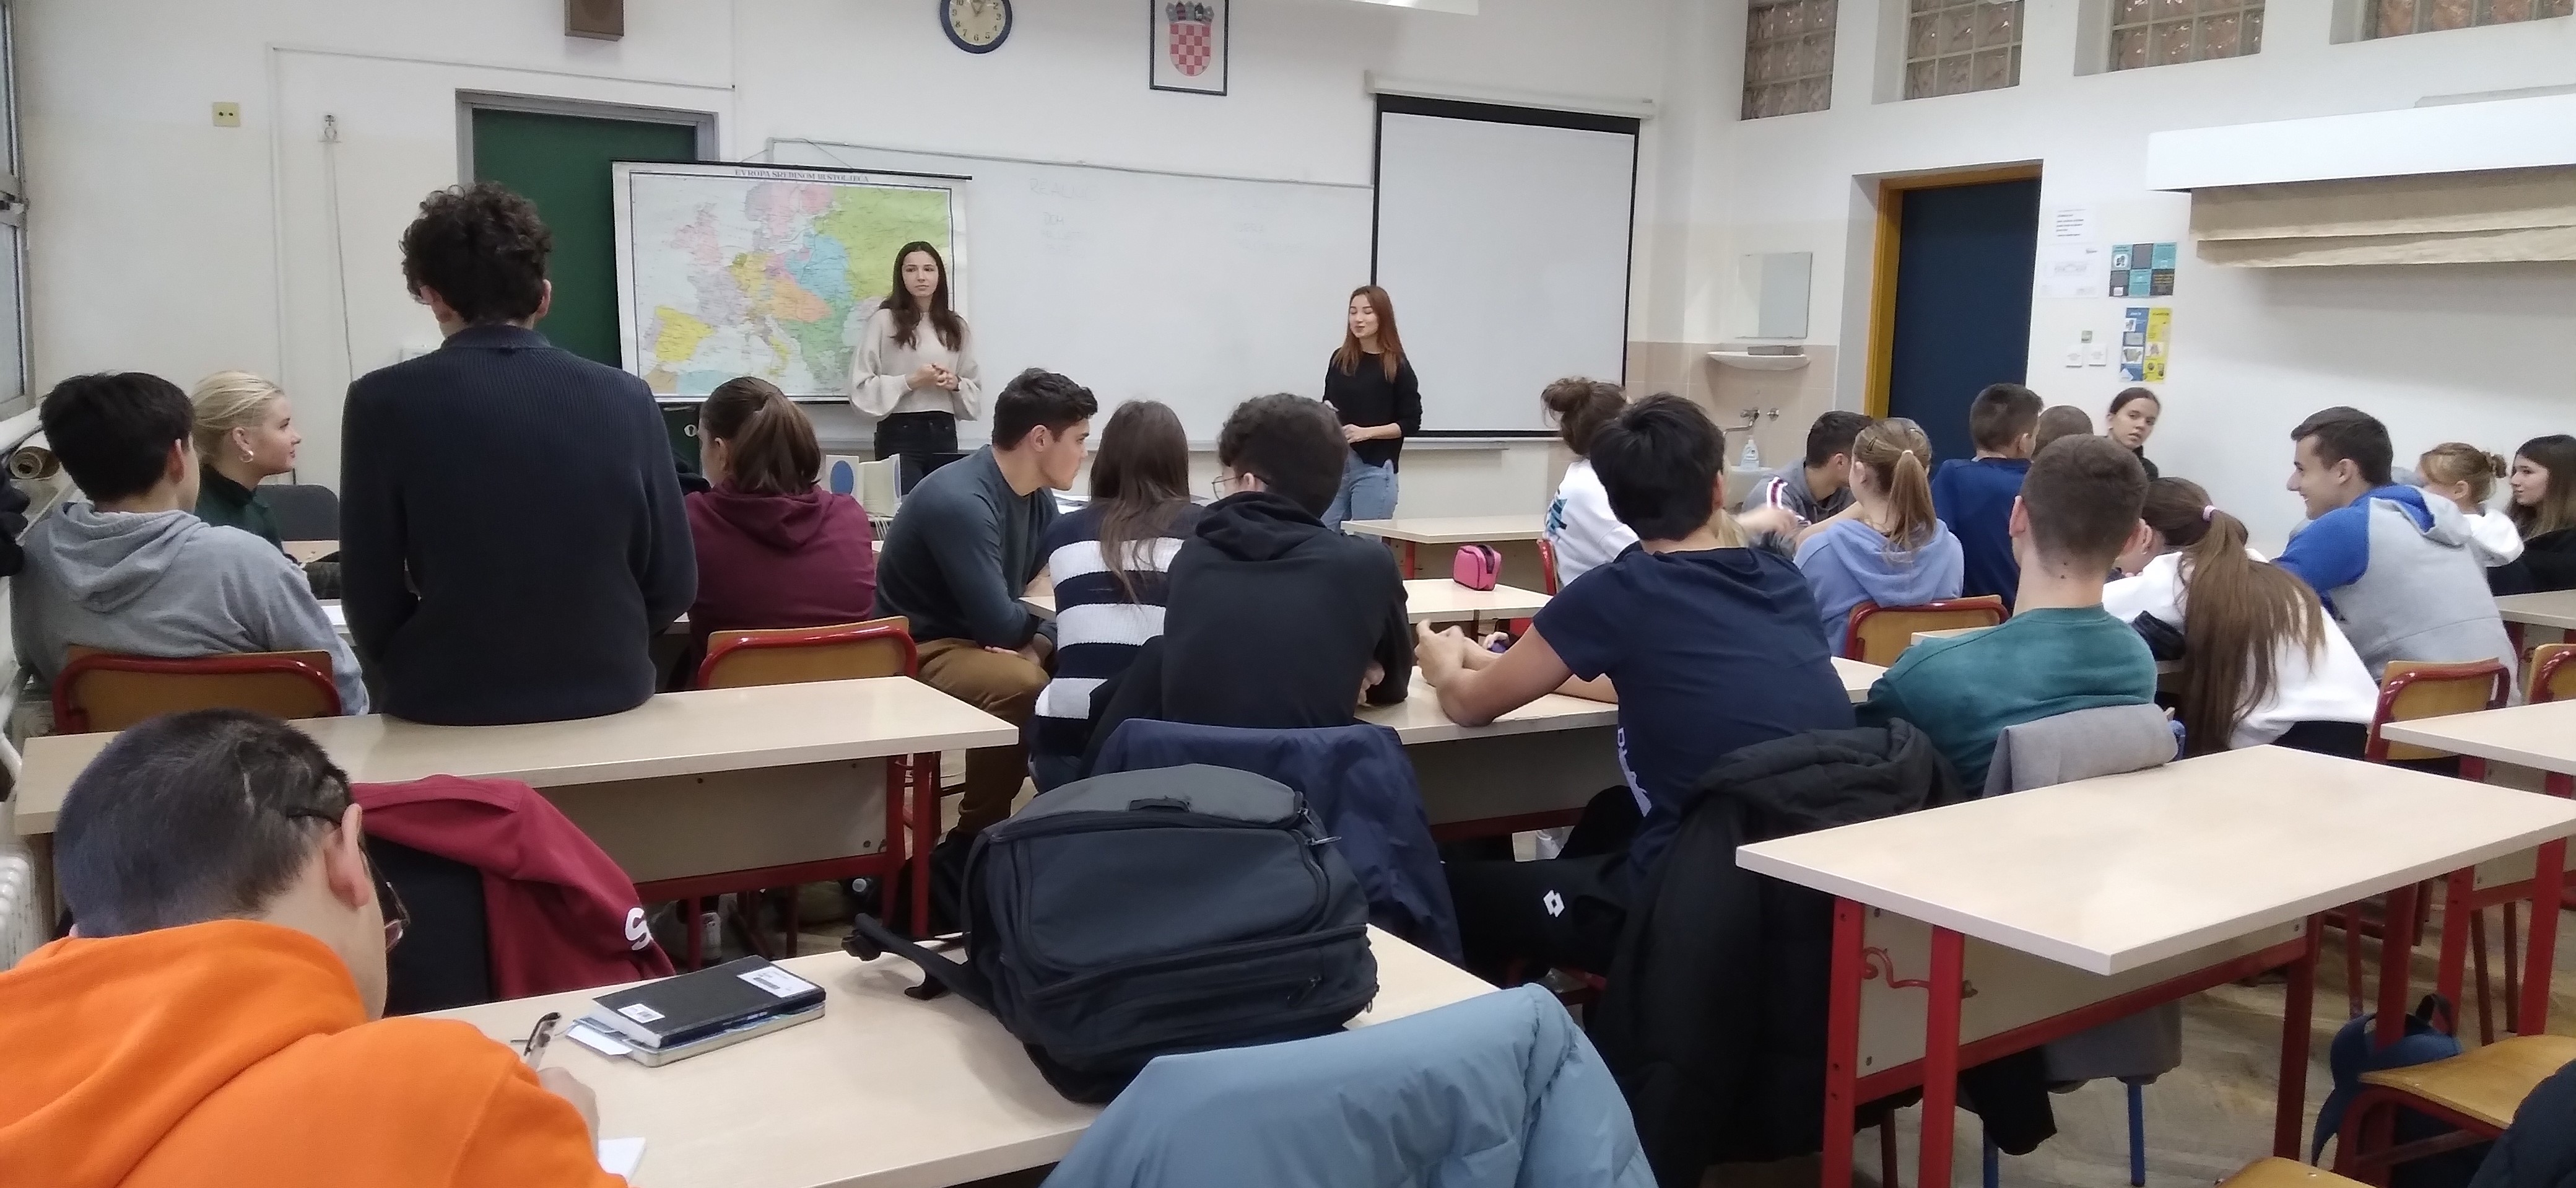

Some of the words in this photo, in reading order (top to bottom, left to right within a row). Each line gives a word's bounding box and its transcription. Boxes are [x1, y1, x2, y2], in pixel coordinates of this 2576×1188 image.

[993, 2, 999, 10] 2
[734, 168, 770, 177] EVROPA
[772, 170, 815, 180] SREDINOM
